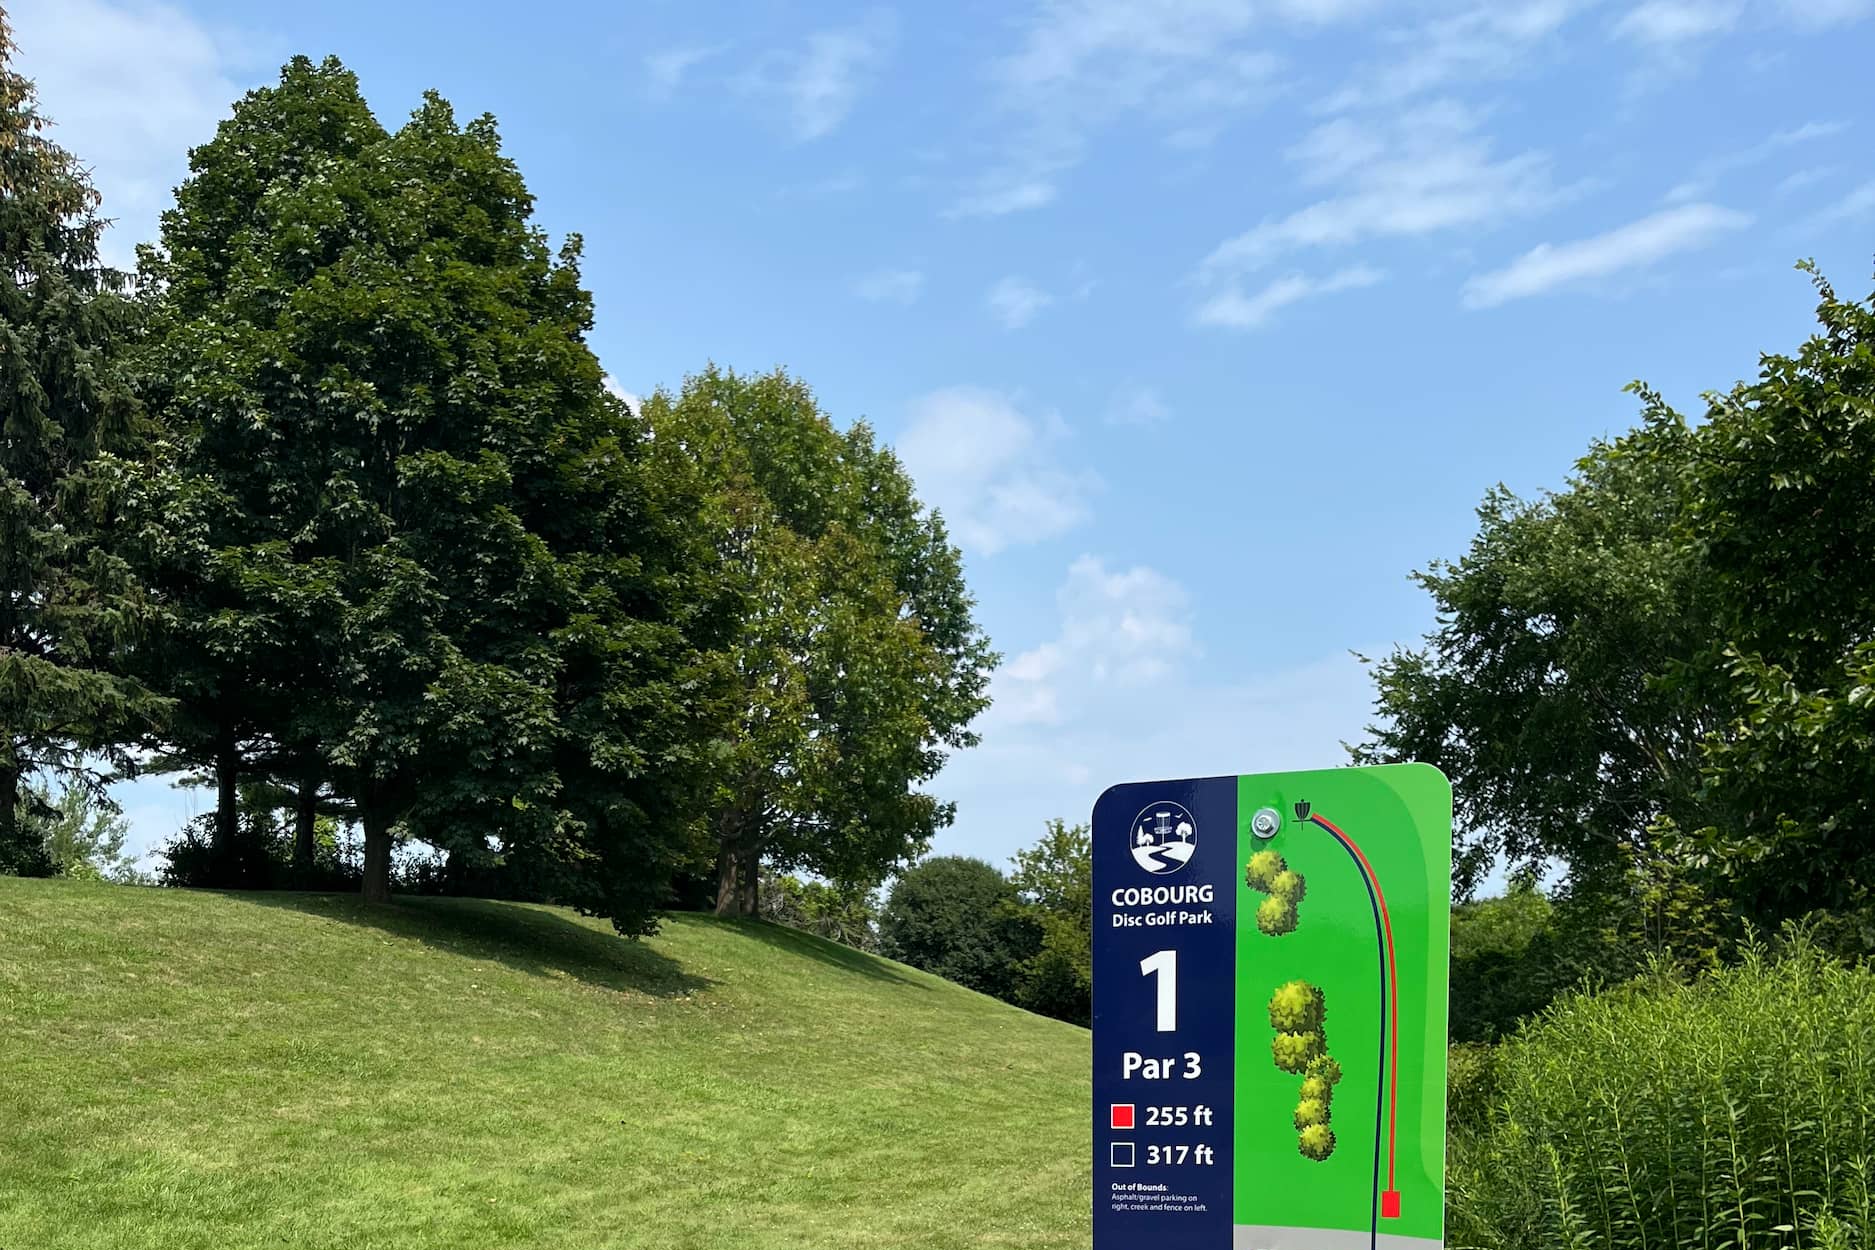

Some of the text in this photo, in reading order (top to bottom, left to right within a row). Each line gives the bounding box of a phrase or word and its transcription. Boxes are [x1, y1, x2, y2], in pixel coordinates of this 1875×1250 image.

[1111, 884, 1214, 907] COBOURG
[1112, 909, 1213, 928] Disc Golf Park
[1139, 950, 1177, 1032] 1
[1123, 1051, 1202, 1080] Par 3
[1145, 1104, 1213, 1126] 255 ft
[1146, 1143, 1214, 1165] 317 ft
[1111, 1182, 1168, 1192] Out of Bounds:
[1111, 1193, 1160, 1202] Asphalt/gravel
[1160, 1194, 1187, 1203] parking
[1130, 1203, 1149, 1211] creek
[1150, 1203, 1163, 1211] and
[1163, 1203, 1182, 1212] fence
[1194, 1204, 1207, 1212] left.
